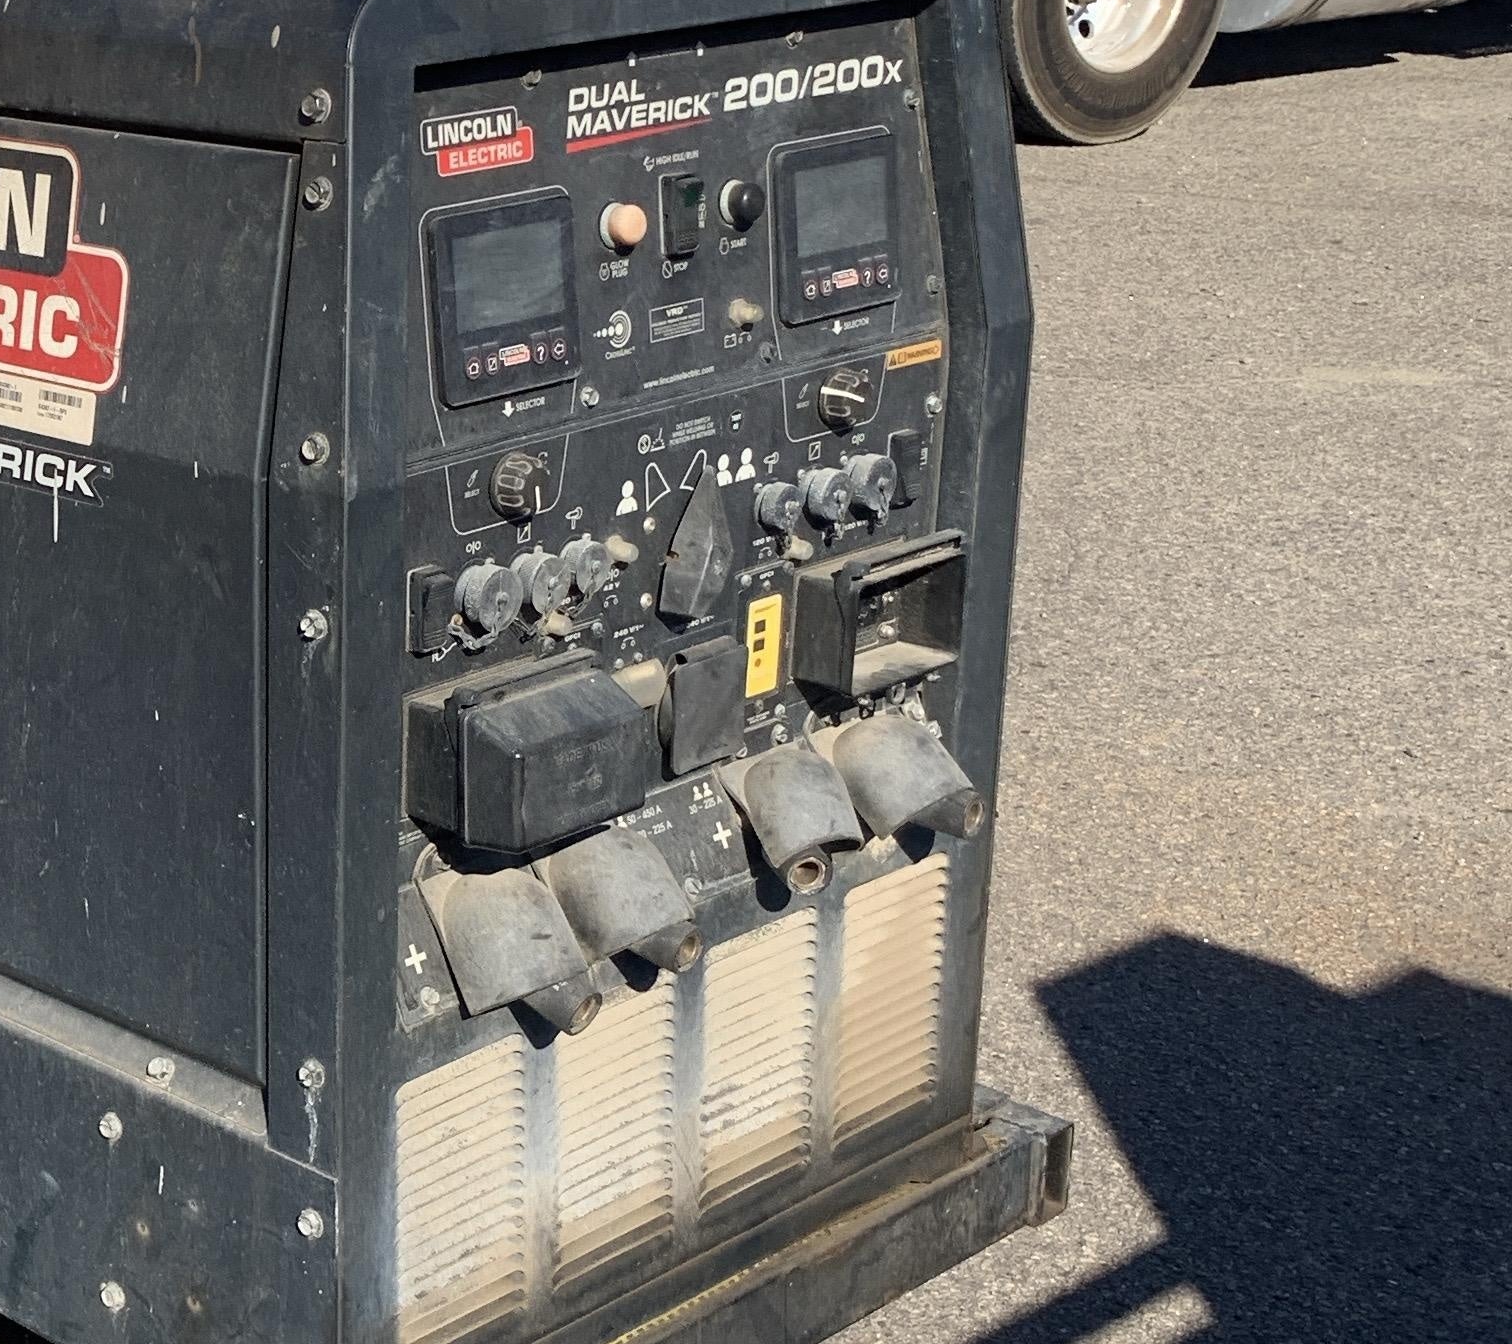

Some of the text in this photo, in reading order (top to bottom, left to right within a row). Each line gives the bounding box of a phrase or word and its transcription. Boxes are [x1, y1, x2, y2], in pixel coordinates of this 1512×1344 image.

[568, 79, 645, 112] DUAL
[566, 93, 711, 139] MAVERICK
[426, 112, 512, 149] LINCOLN
[448, 140, 523, 169] ELECTRIC
[730, 238, 747, 249] START
[609, 259, 629, 271] GLOW
[673, 262, 688, 273] STOP
[611, 267, 629, 279] PLUG
[516, 397, 545, 412] SELECTOR
